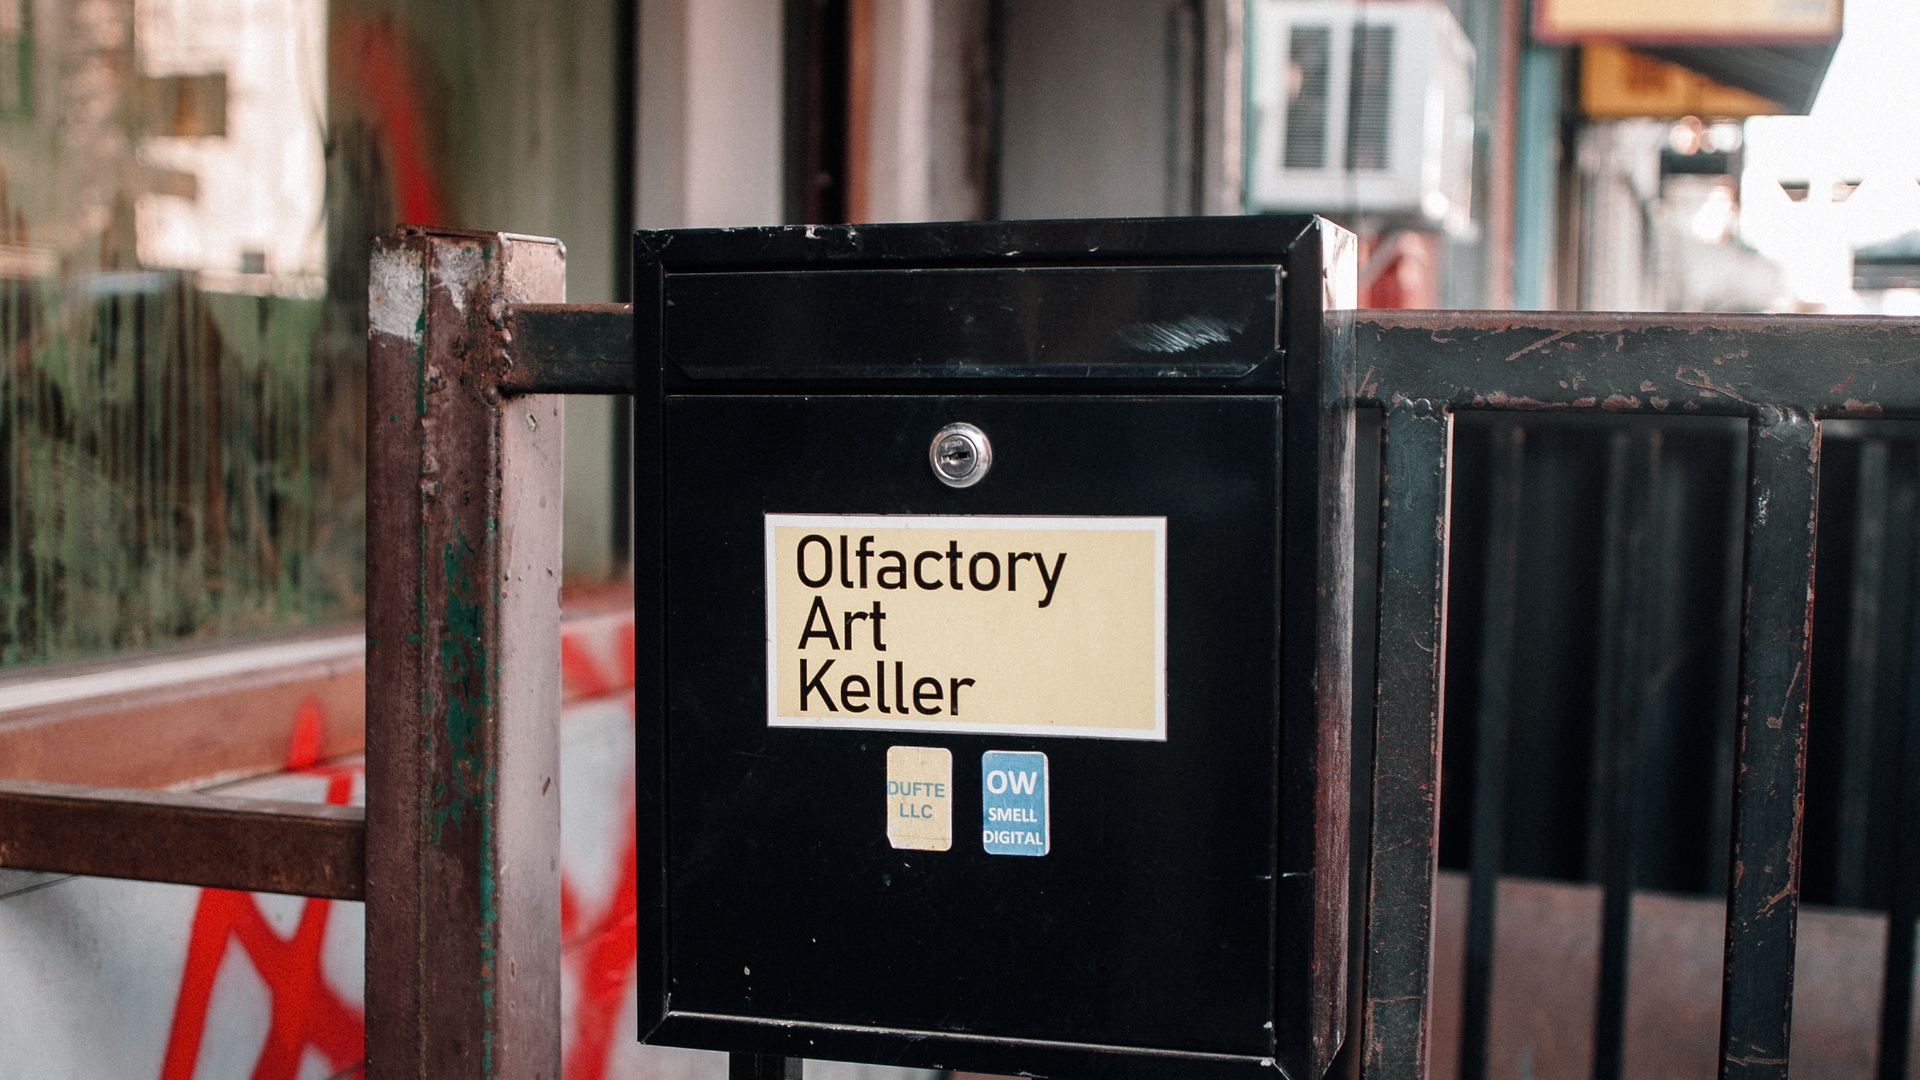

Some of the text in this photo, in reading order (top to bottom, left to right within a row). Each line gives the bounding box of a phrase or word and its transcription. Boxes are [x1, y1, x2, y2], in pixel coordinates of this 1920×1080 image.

[797, 534, 1067, 608] Olfactory
[797, 596, 887, 651] Art
[799, 658, 976, 716] Keller
[887, 780, 946, 798] DUFTE
[986, 770, 1038, 796] OW
[899, 803, 933, 819] LLC
[988, 806, 1038, 823] SMELL
[983, 830, 1044, 846] DIGITAL
